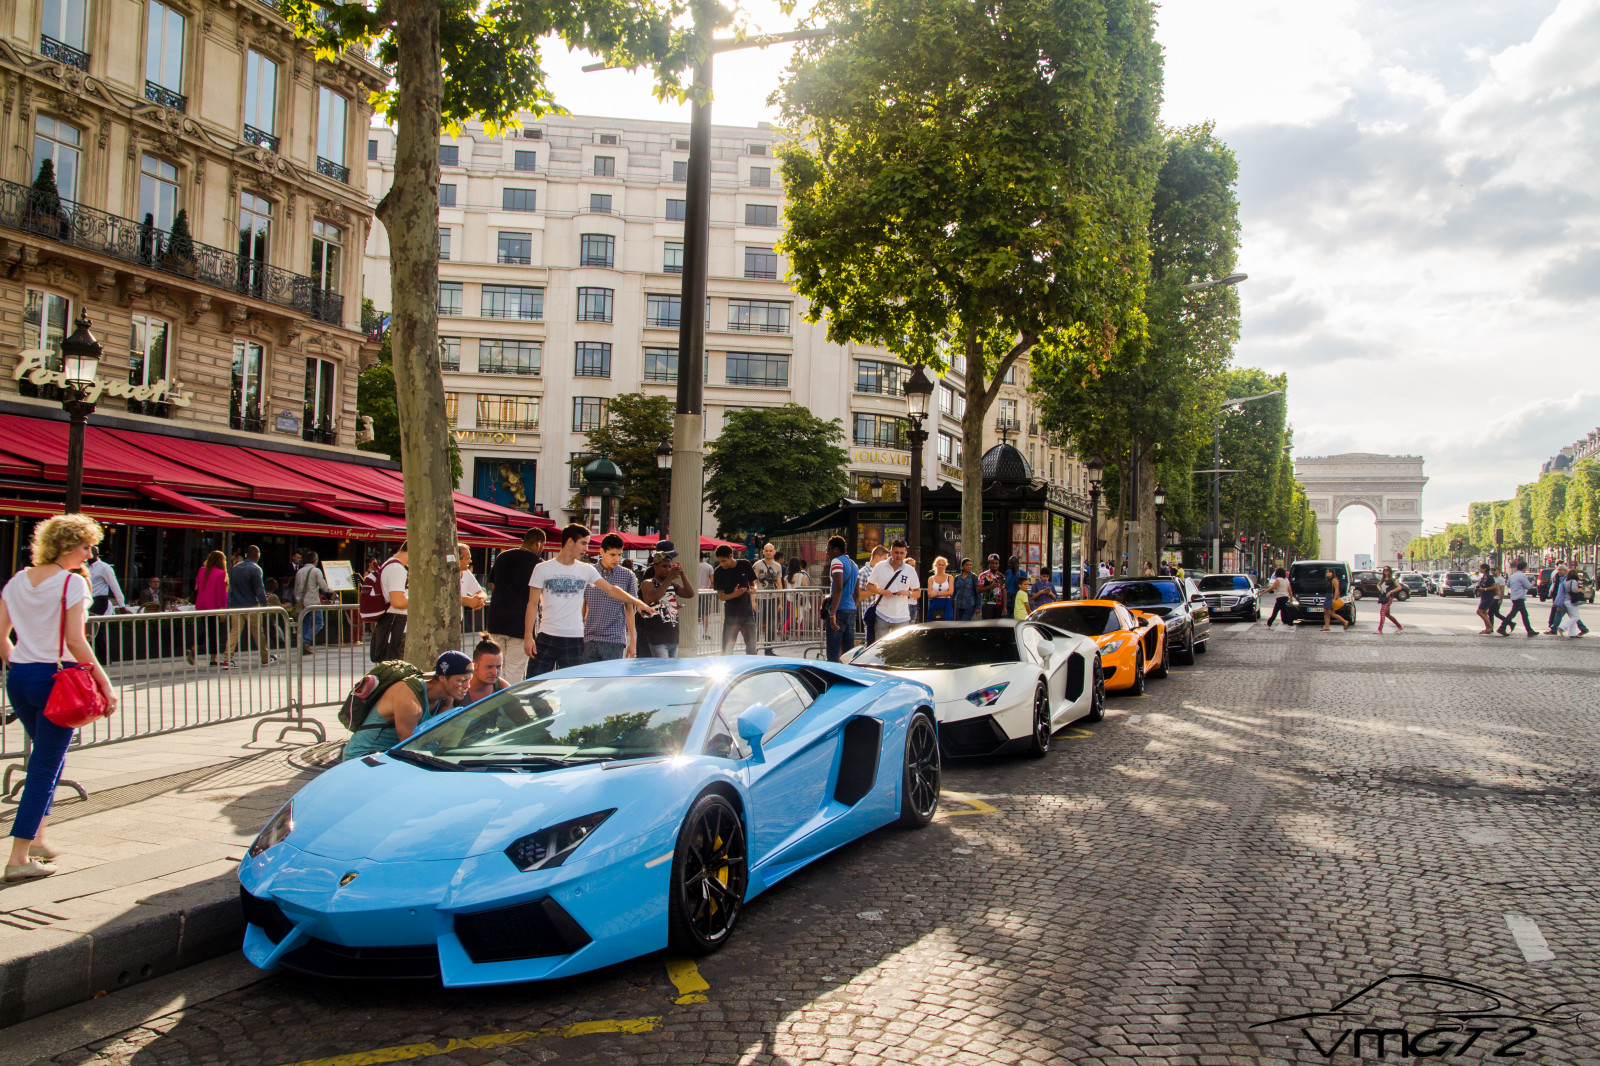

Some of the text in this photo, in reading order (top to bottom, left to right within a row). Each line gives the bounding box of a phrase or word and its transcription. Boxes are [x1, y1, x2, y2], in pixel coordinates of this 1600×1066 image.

[456, 430, 516, 444] VUITTON
[854, 450, 888, 464] LOUIS
[900, 574, 908, 584] H
